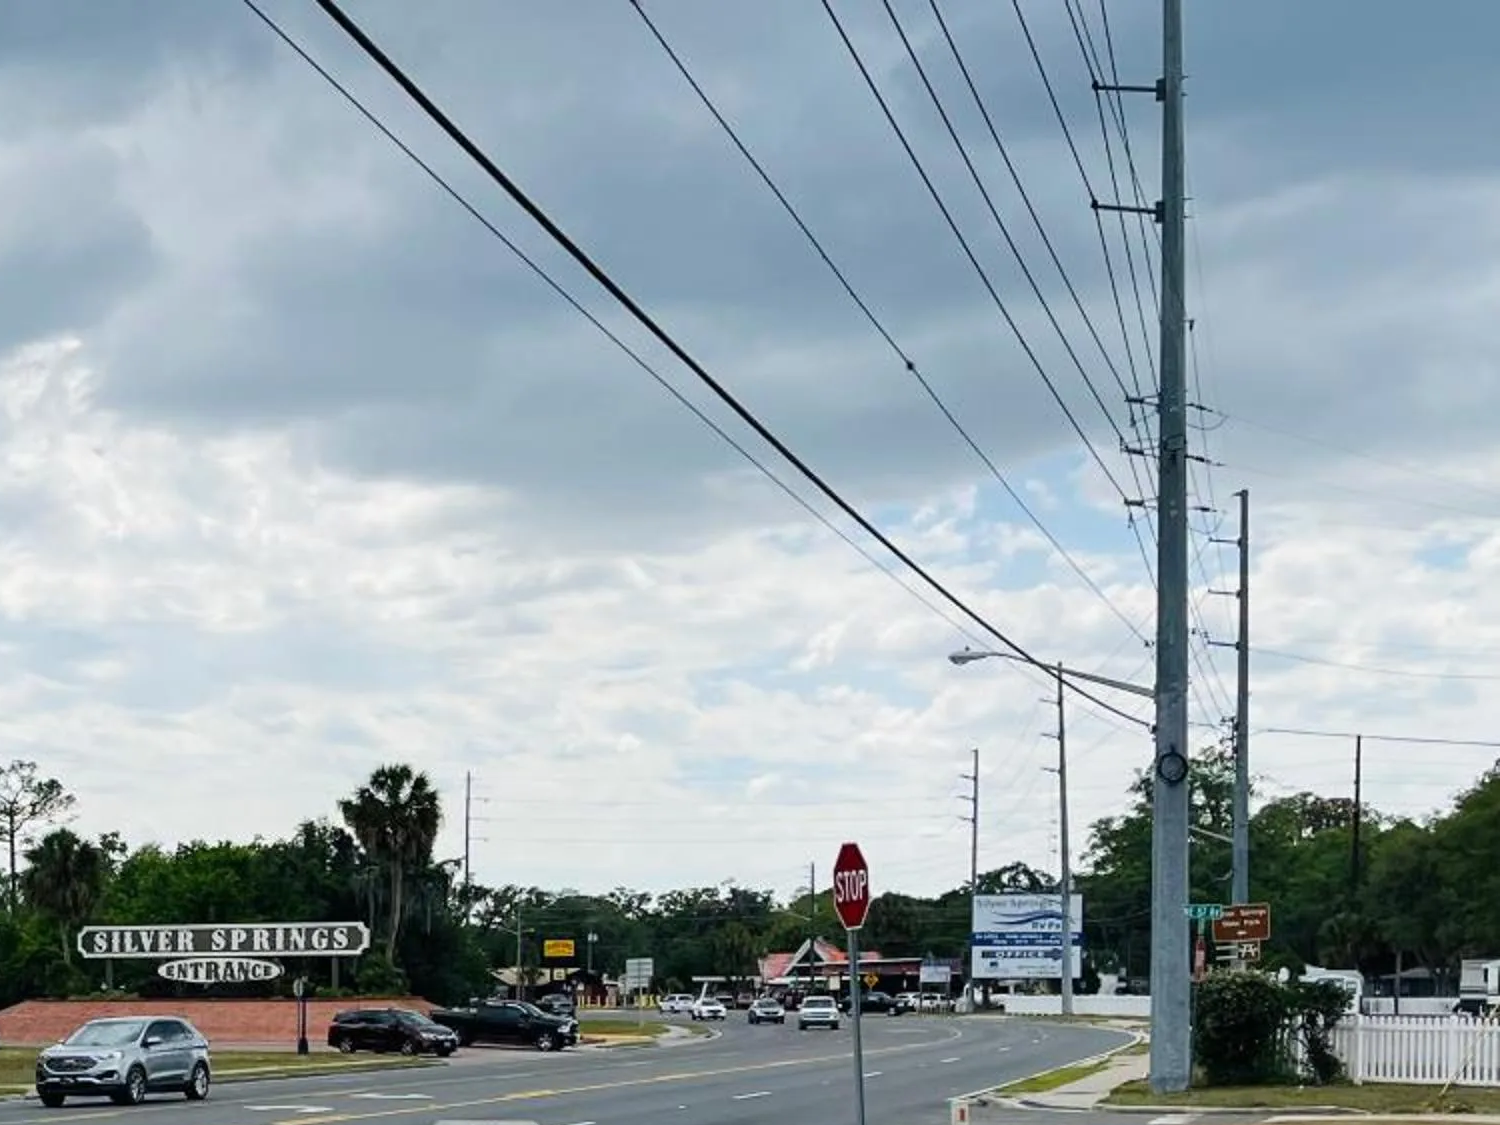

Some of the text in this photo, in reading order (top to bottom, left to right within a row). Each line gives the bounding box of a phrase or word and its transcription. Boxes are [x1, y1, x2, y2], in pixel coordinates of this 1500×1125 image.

[835, 869, 867, 903] STOP
[93, 925, 350, 953] SILVER SPRINGS
[164, 960, 275, 982] ENTRANCE
